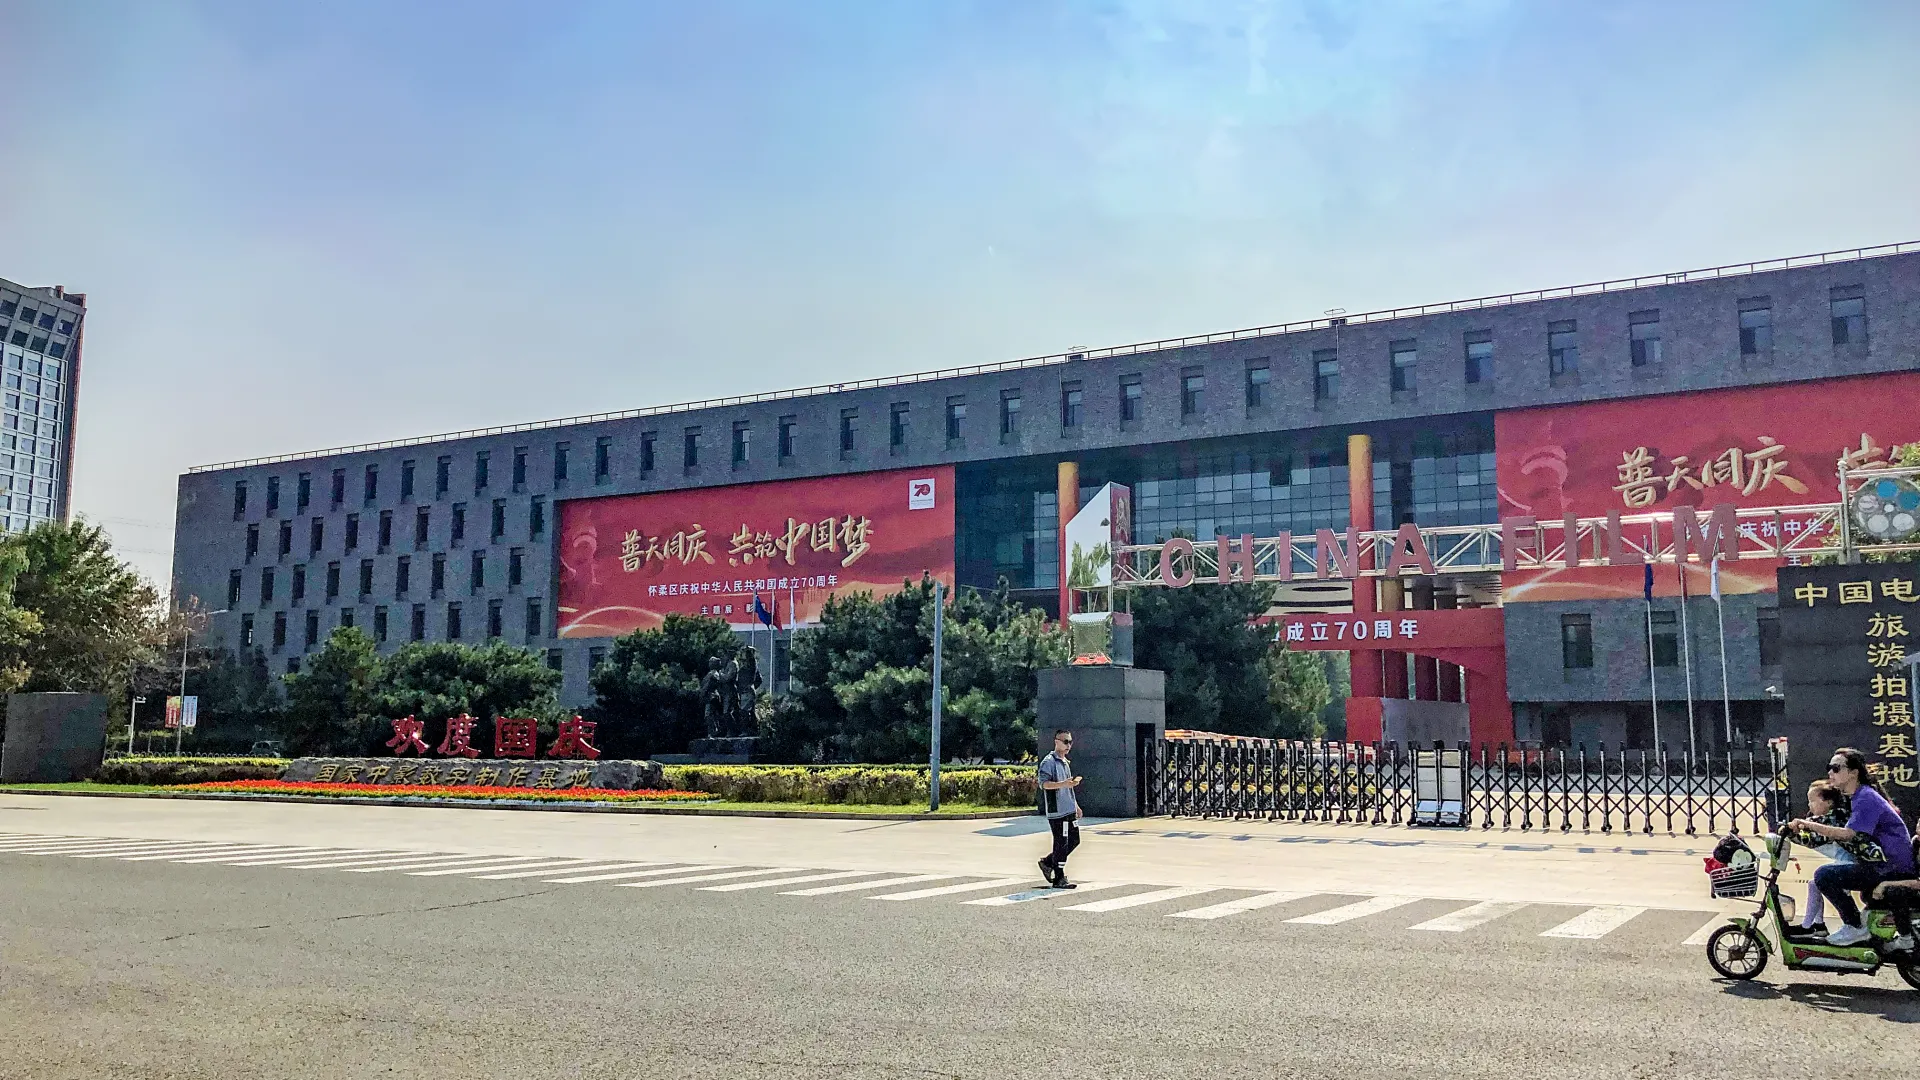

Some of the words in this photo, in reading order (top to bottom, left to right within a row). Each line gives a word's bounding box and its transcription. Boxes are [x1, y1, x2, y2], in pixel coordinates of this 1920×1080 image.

[1613, 437, 1808, 507] 普天同庆
[618, 523, 714, 573] 普天同庆
[728, 514, 874, 568] 共筑中国梦
[1161, 523, 1437, 588] CHINA
[1501, 505, 1740, 571] FILM
[648, 574, 838, 596] 怀柔区庆祝中华人民共和国成立70周年
[1794, 577, 1920, 607] 中国电
[1248, 619, 1419, 642] 成立70周年
[1865, 612, 1920, 788] 旅游拍摄基地
[386, 713, 600, 759] 欢度国庆
[314, 764, 592, 789] 国家中影数字制作基地
